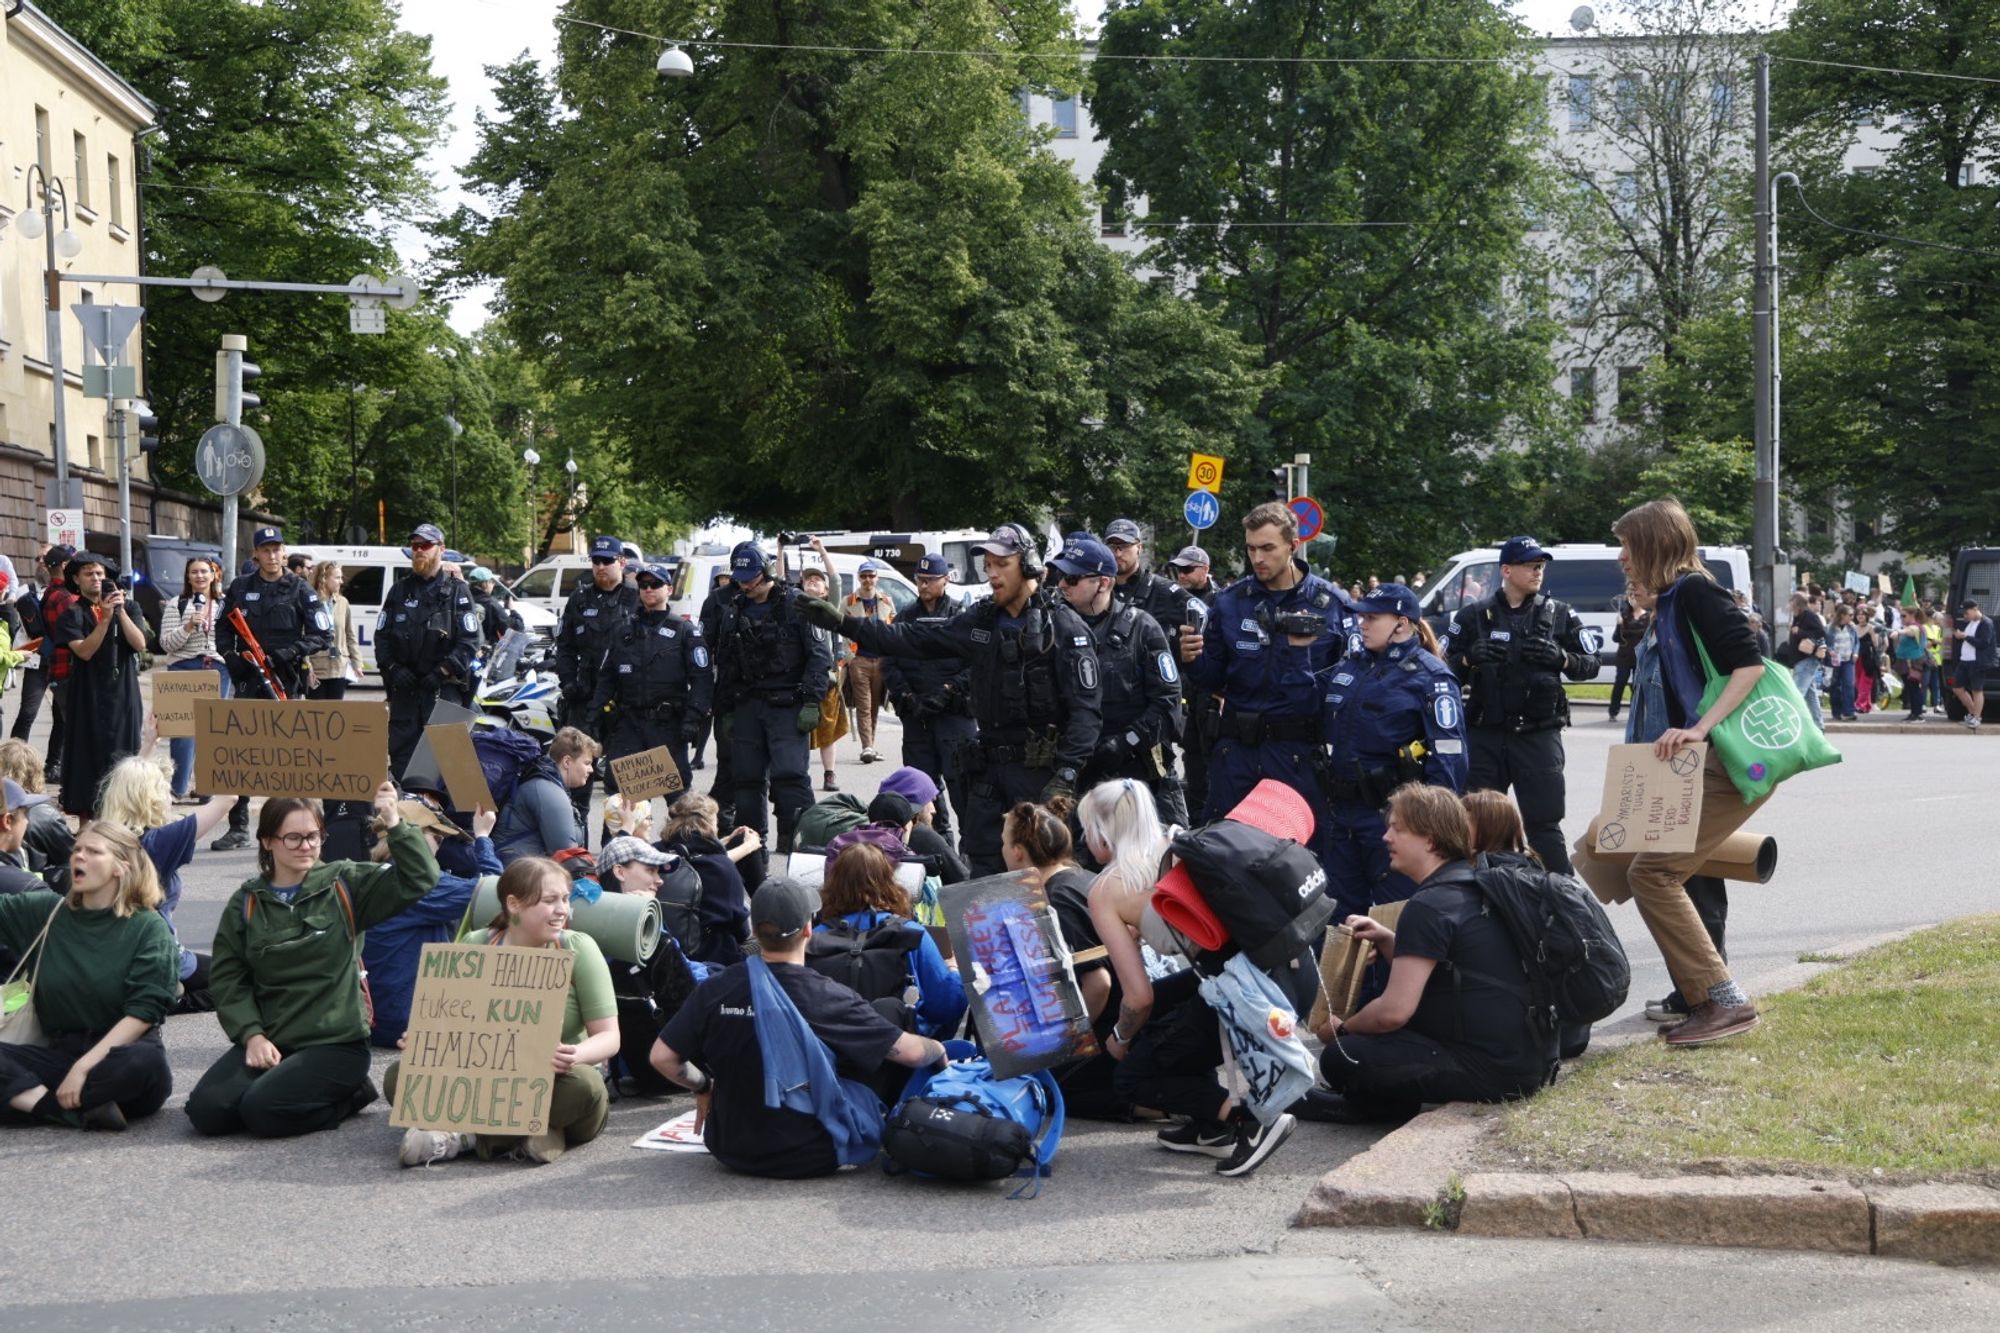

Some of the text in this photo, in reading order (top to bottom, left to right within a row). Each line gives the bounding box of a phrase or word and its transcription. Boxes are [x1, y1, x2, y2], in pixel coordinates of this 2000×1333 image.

[1199, 467, 1213, 480] 30
[352, 550, 368, 558] 118
[885, 548, 901, 557] 730
[209, 706, 345, 741] LAJIKATO
[213, 746, 337, 767] OIKEUDEN-
[211, 769, 372, 794] MUKAISUUSKATO
[1644, 796, 1664, 841] EI MUN
[422, 950, 570, 990] MIKSI HALLITUS
[418, 987, 543, 1025] tukee, KUN
[408, 1028, 520, 1072] IHMISIÄ
[399, 1074, 549, 1127] KUOLEE?
